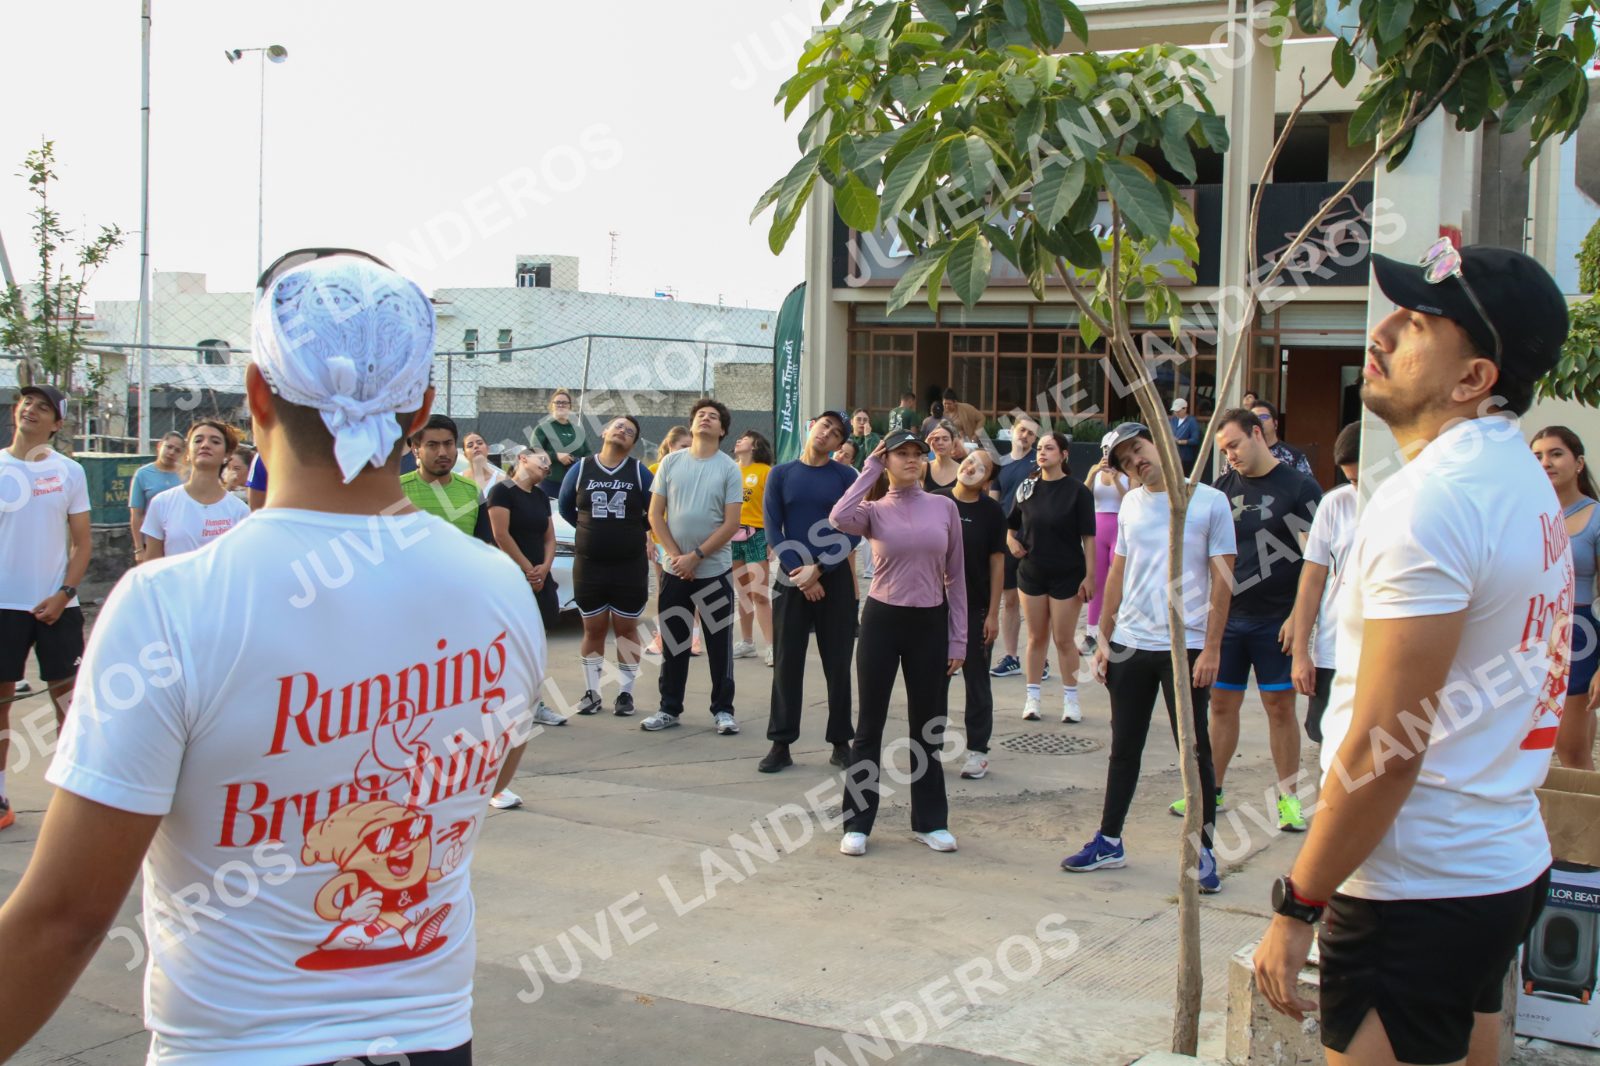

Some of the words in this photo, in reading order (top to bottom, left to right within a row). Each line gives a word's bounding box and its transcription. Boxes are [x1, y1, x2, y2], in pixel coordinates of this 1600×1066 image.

[111, 479, 125, 490] 25
[586, 479, 612, 490] LONG
[611, 479, 634, 490] LIVE
[591, 491, 627, 518] 24
[263, 631, 507, 757] Running
[214, 721, 517, 847] Brunhing
[1548, 888, 1573, 900] LOR
